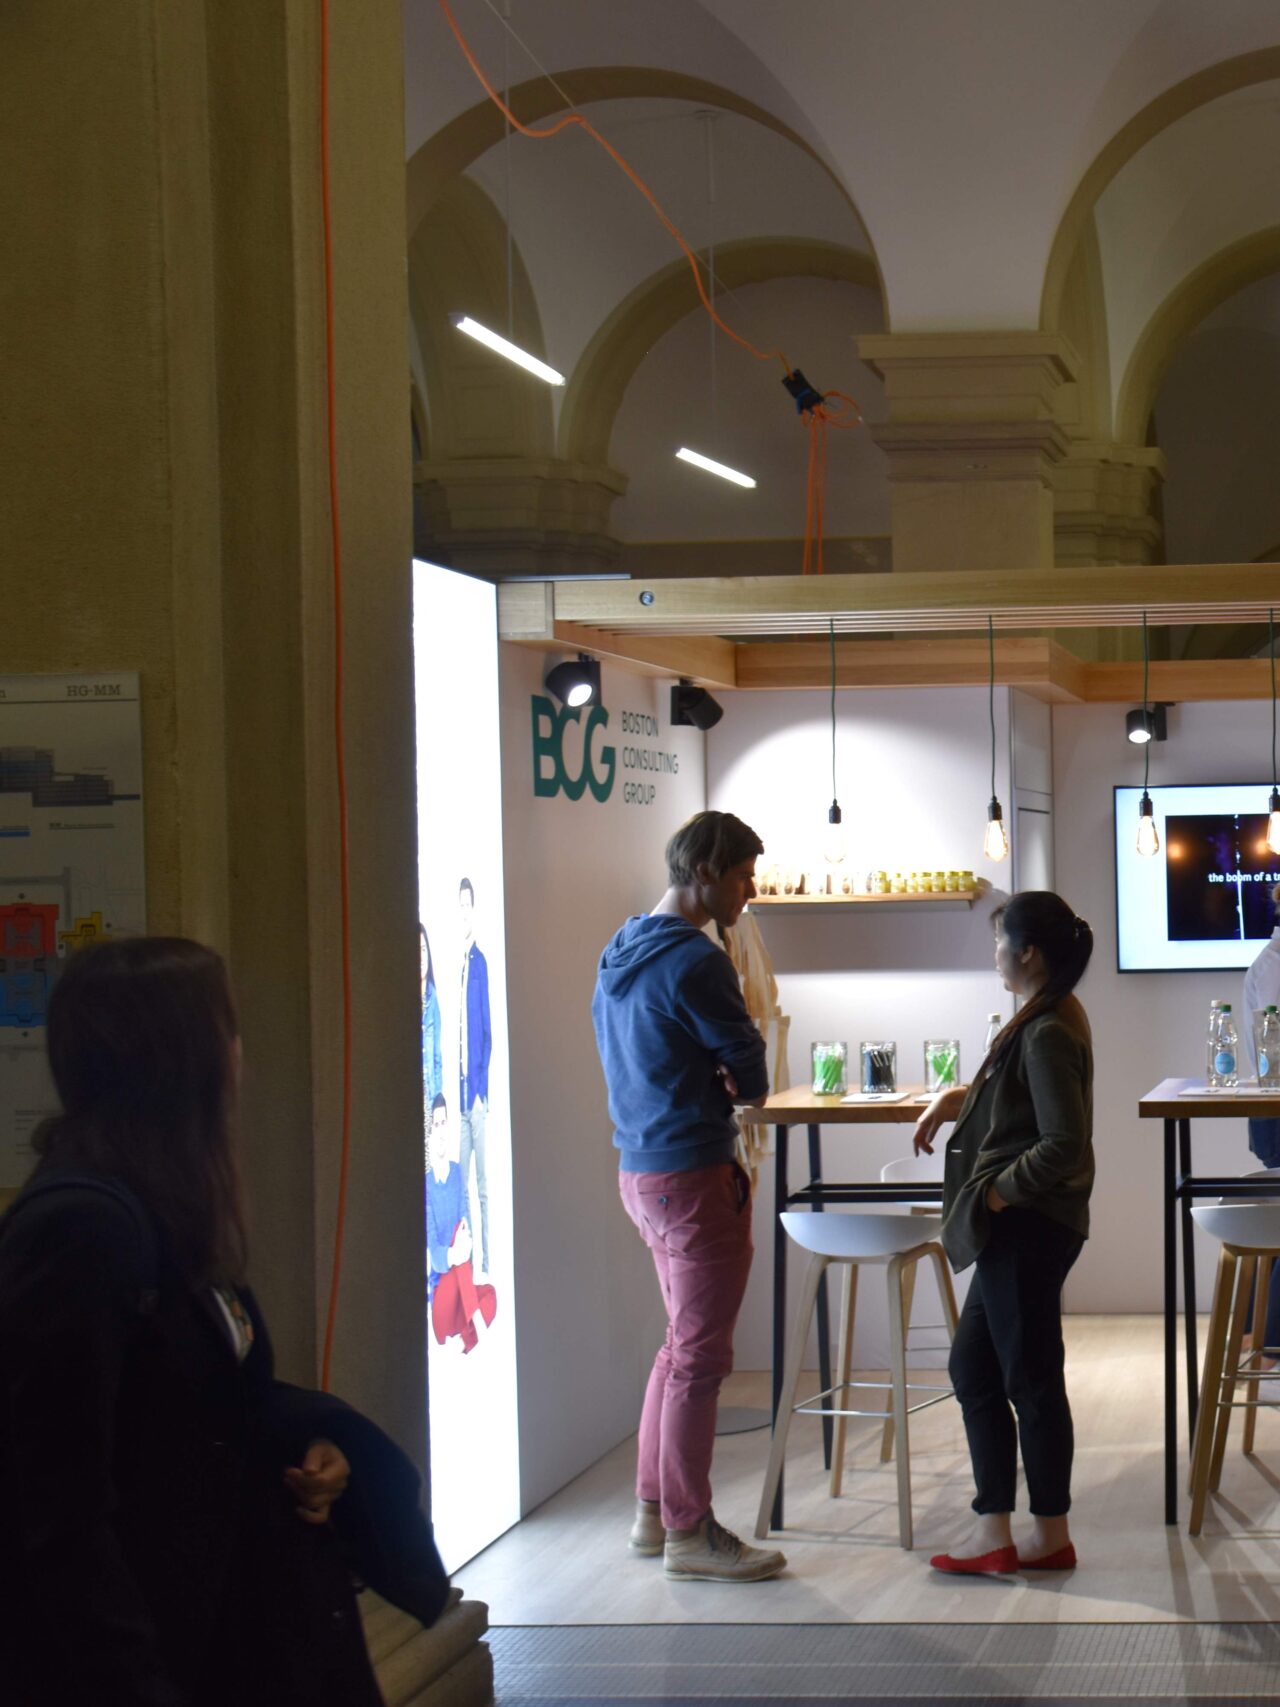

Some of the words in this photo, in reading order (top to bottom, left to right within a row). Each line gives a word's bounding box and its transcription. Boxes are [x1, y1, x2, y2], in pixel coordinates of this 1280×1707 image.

[67, 685, 121, 697] HG-MM
[622, 711, 659, 737] BOSTON
[531, 695, 616, 803] BCG
[623, 747, 679, 774] CONSULTING
[624, 782, 656, 805] GROUP
[1208, 873, 1224, 882] the
[1254, 872, 1265, 881] of
[1265, 873, 1272, 881] a
